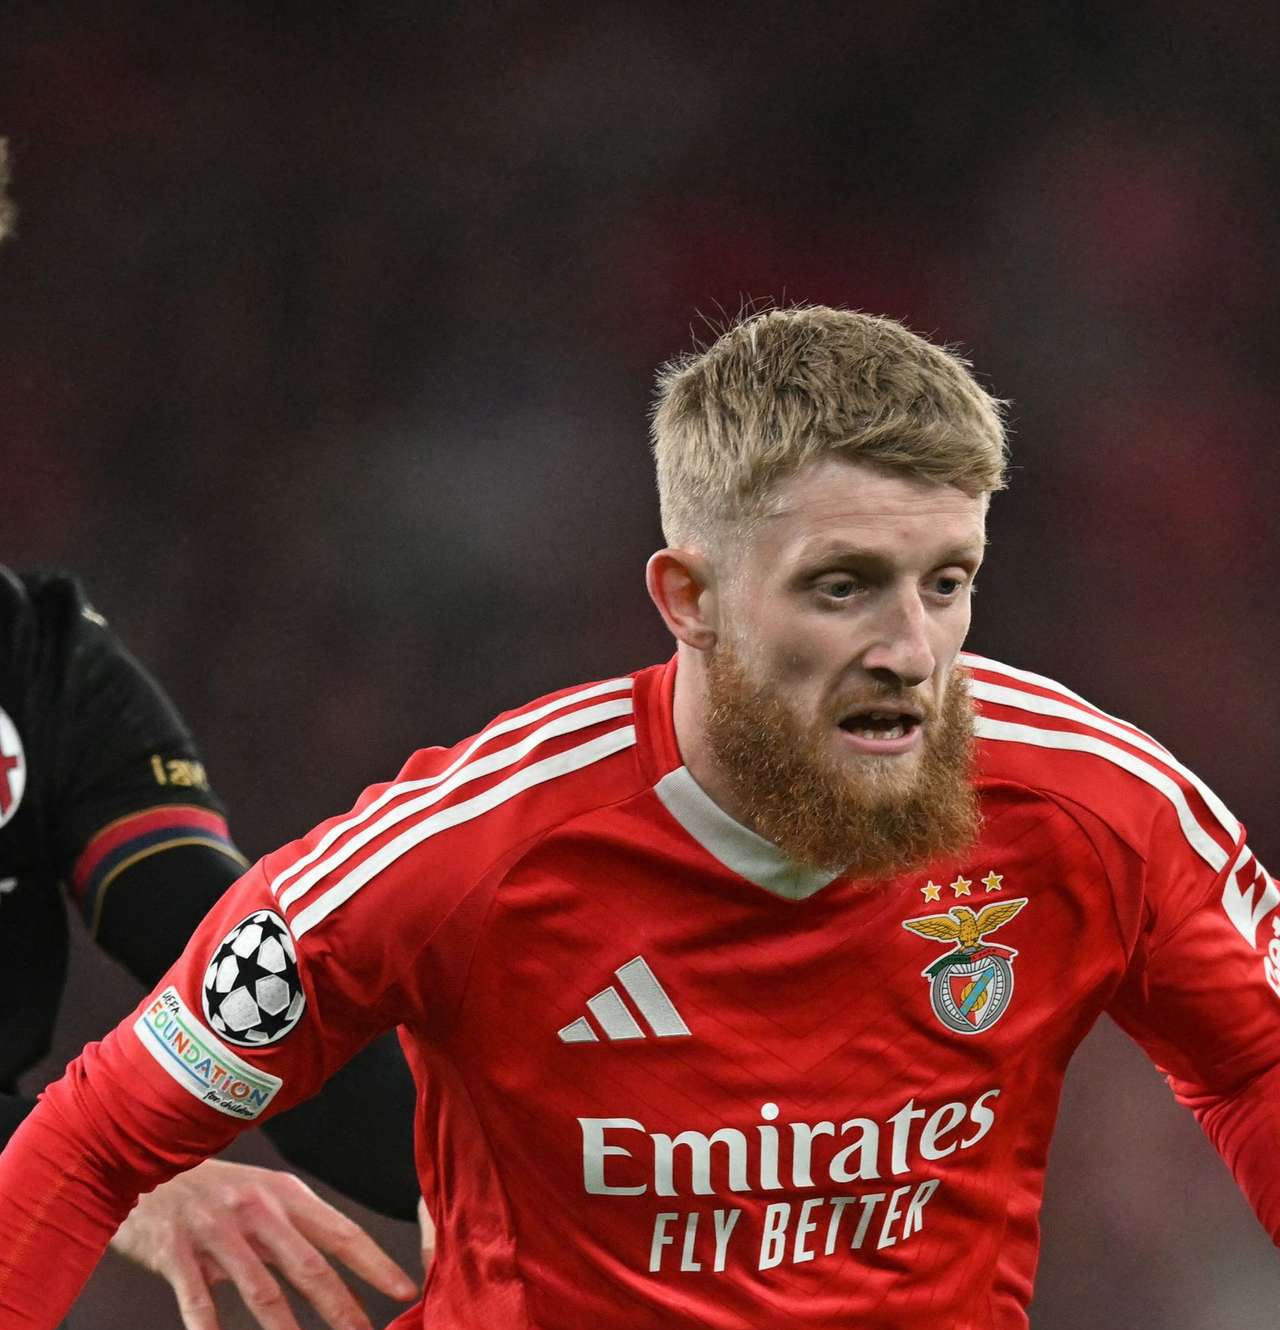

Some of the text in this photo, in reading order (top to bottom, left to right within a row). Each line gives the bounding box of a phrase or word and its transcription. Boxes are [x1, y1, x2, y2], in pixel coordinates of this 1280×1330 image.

[162, 991, 180, 1015] UEFA
[147, 1002, 269, 1108] FOUNDATION
[576, 1088, 1001, 1198] Emirates
[648, 1178, 941, 1273] FLY BETTER
